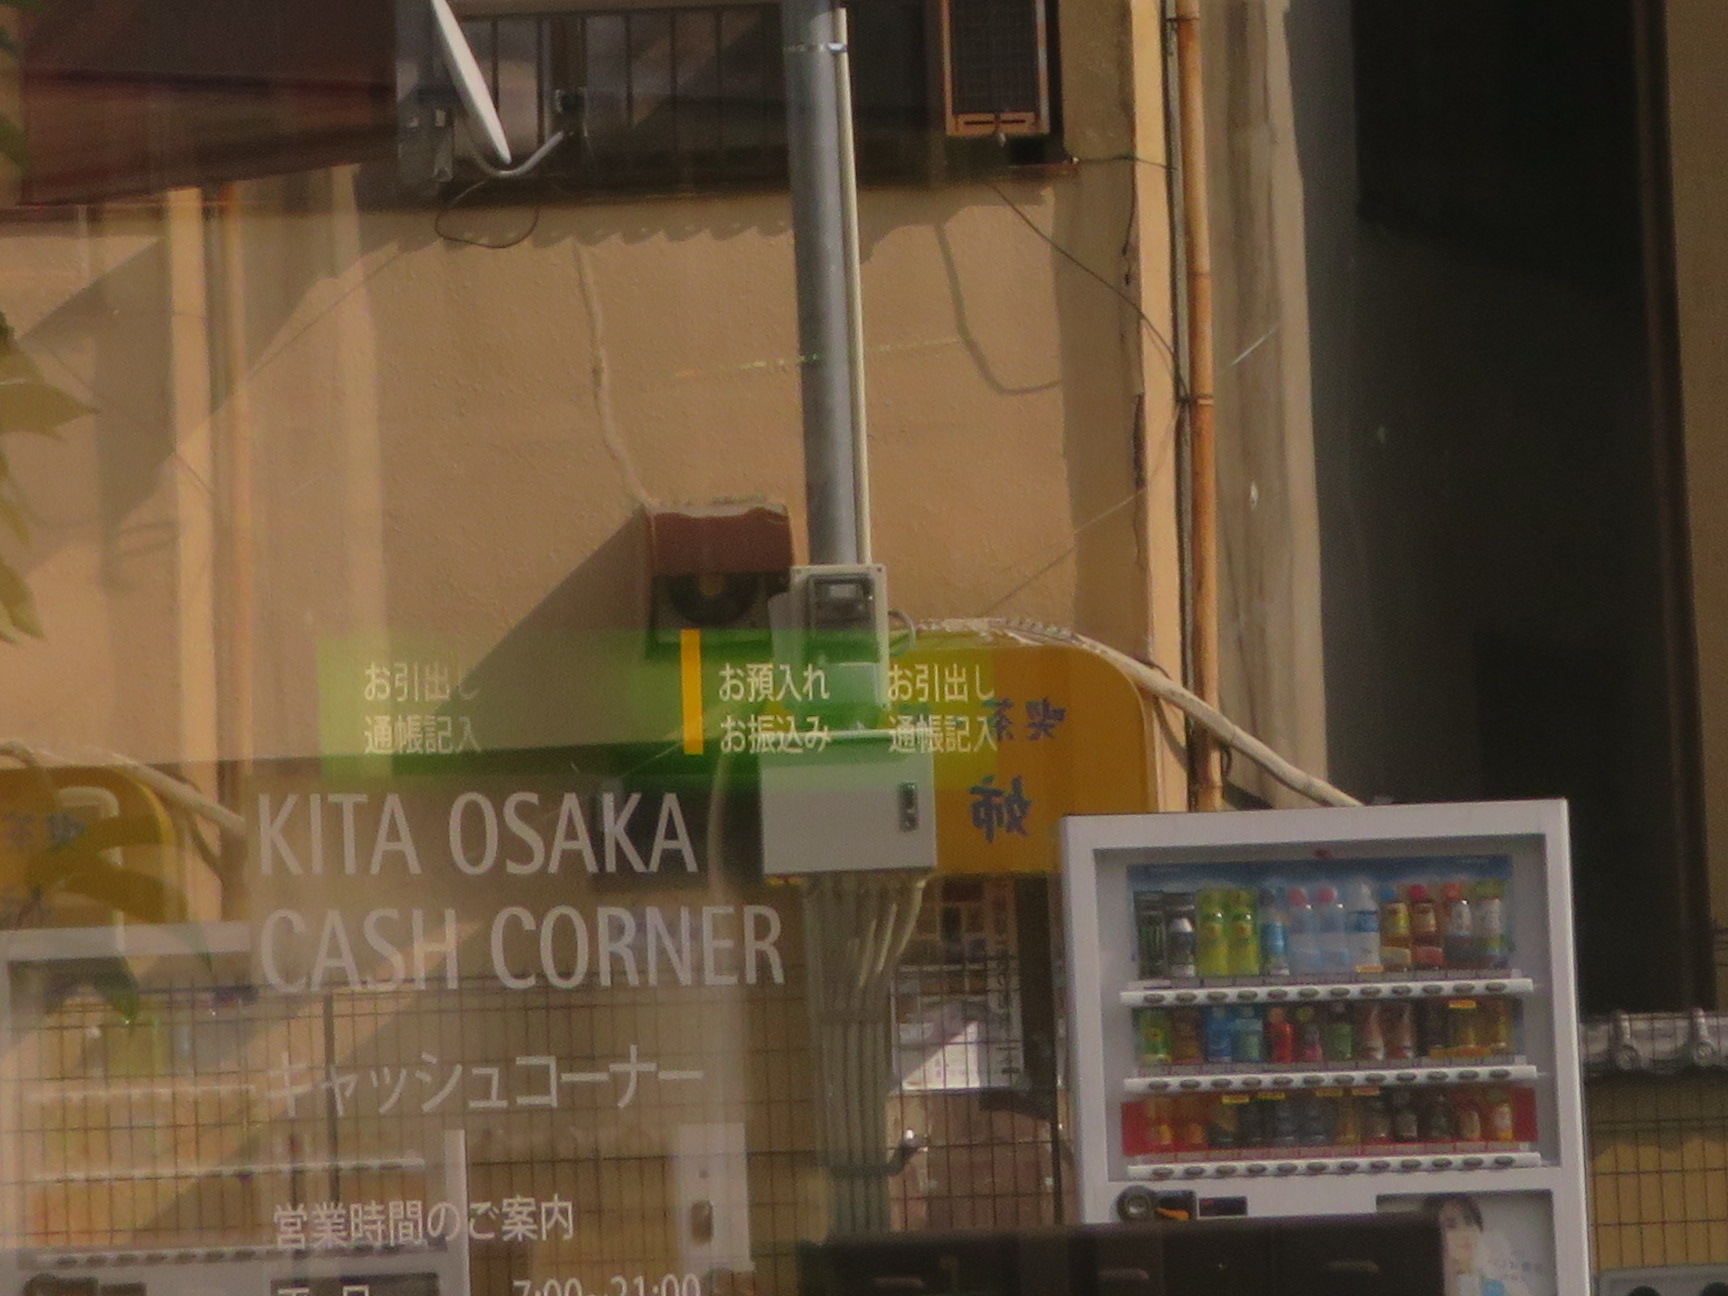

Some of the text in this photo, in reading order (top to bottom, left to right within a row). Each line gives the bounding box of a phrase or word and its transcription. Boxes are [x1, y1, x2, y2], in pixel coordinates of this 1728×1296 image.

[363, 660, 482, 703] お引出し
[718, 662, 831, 703] お預入れ
[886, 662, 996, 703] お引出し
[363, 713, 482, 755] 通帳記入
[719, 714, 832, 755] お振込み
[887, 714, 998, 755] 通帳記入
[258, 790, 699, 876] KITA OSAKA
[259, 904, 786, 994] CASH CORNER
[264, 1043, 705, 1118] キャッシュコーナー
[272, 1193, 575, 1251] 営業時間のご案内
